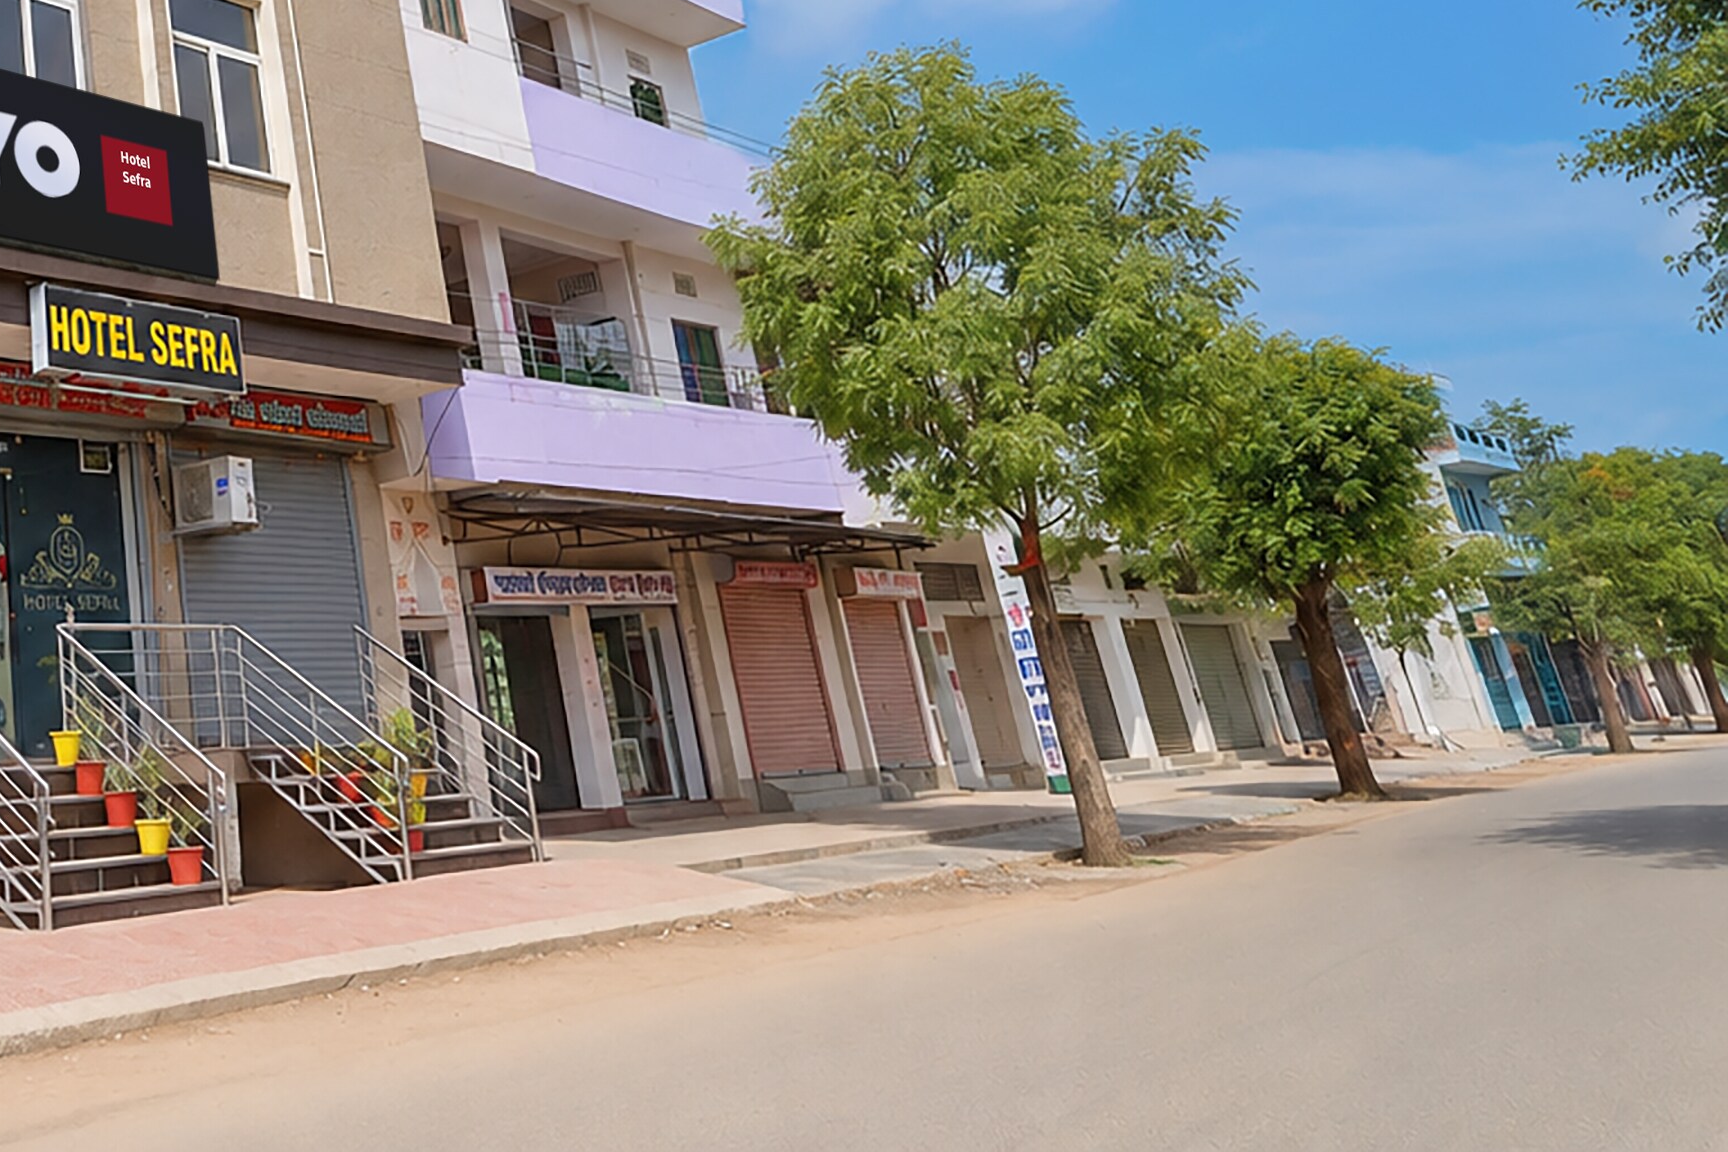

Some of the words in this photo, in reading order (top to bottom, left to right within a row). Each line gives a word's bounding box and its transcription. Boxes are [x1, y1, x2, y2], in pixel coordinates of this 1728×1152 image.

[120, 150, 151, 169] Hotel
[122, 170, 152, 189] Sefra
[49, 304, 146, 363] HOTEL
[149, 320, 239, 377] SEFRA
